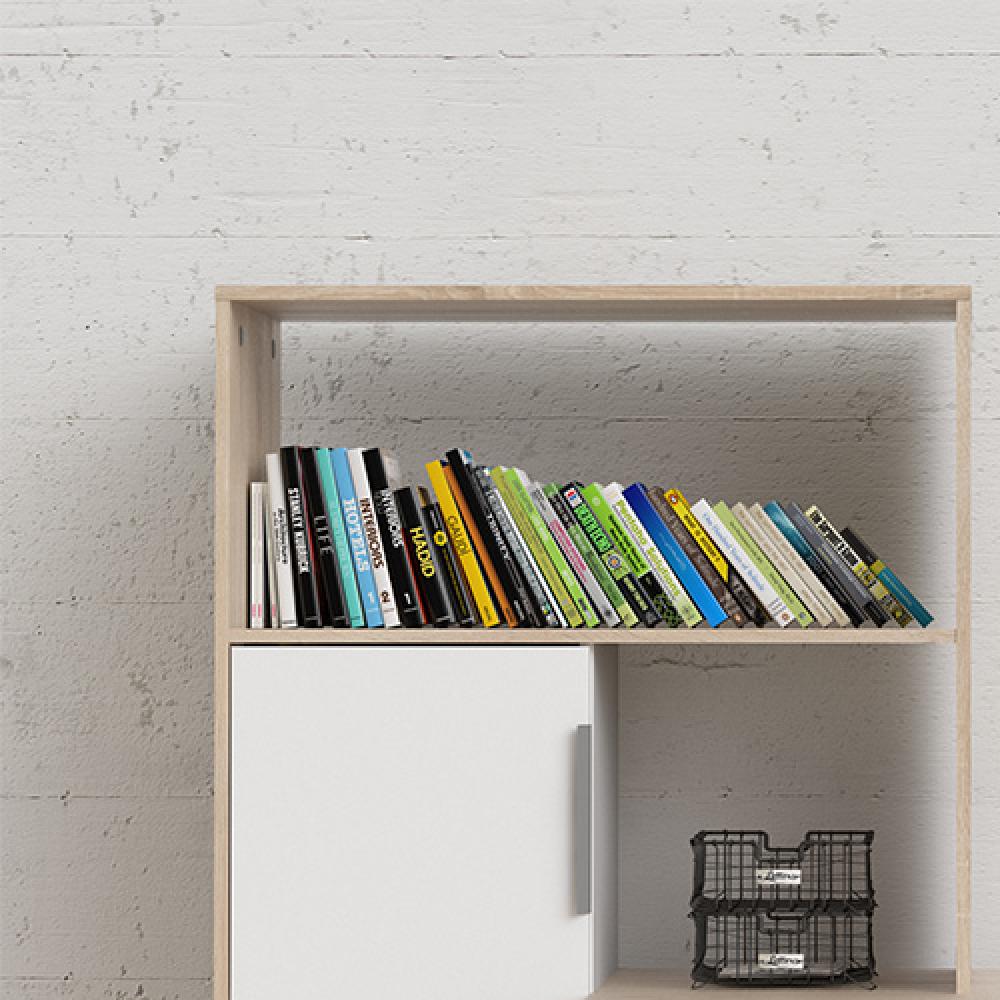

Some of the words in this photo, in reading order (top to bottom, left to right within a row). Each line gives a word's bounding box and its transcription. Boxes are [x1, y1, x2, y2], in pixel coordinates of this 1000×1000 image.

[314, 515, 334, 551] LIFE
[344, 498, 369, 573] HOTELS
[359, 497, 385, 569] INTERIORS
[409, 525, 436, 579] HADID
